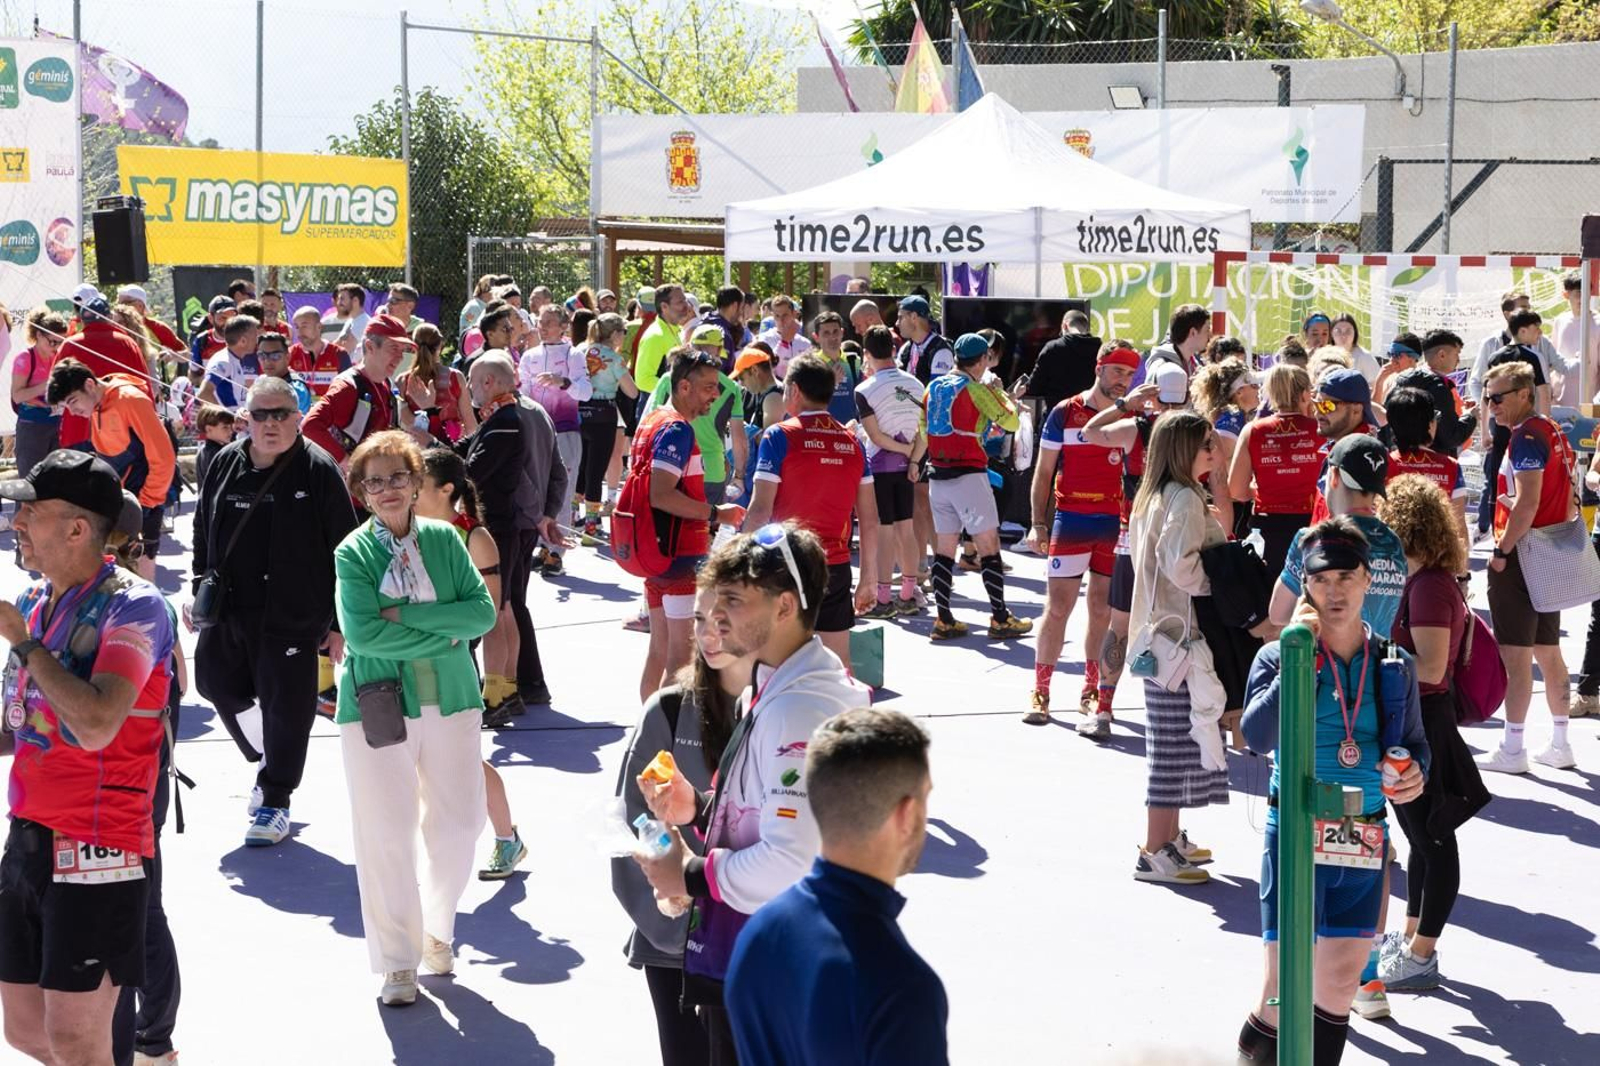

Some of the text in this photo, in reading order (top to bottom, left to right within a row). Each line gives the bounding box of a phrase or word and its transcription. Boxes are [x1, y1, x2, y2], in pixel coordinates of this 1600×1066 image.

[185, 178, 399, 235] masymas
[304, 227, 396, 240] SUPERMERCADOS
[774, 214, 985, 253] time2run.es
[1077, 215, 1221, 254] time2run.es
[1368, 559, 1397, 572] MEDIA
